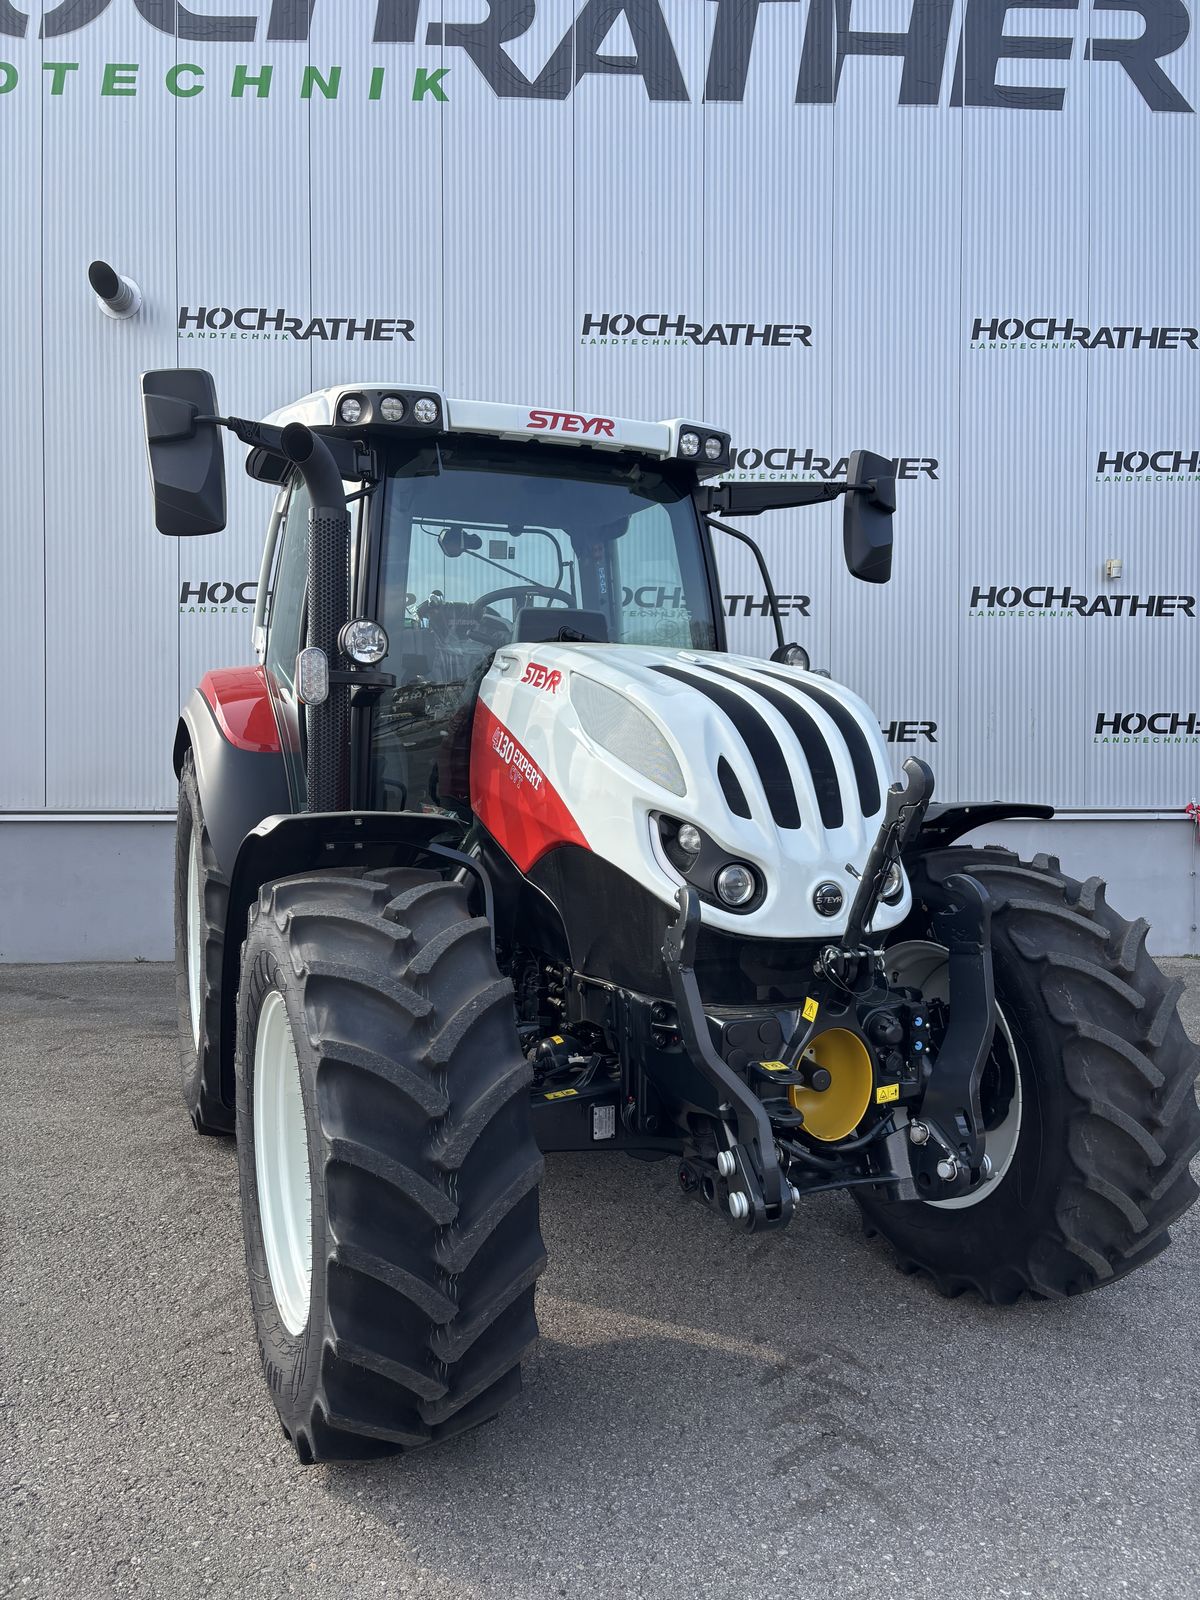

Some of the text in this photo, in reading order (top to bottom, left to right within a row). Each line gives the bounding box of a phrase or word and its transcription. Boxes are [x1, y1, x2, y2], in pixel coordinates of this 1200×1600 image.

[177, 332, 289, 341] LANDTECHNIK
[178, 307, 416, 341] HOCHRATHER
[582, 314, 813, 347] HOCHRATHER
[971, 318, 1199, 349] HOCHRATHER
[581, 338, 689, 346] LANDTECHNIK
[970, 342, 1076, 350] LANDTECHNIK
[527, 410, 615, 437] STEYR
[970, 586, 1196, 617] HOCHRATHER
[521, 662, 562, 694] STEYR
[492, 727, 542, 791] 4130 EXPERT
[816, 896, 842, 904] STEYR
